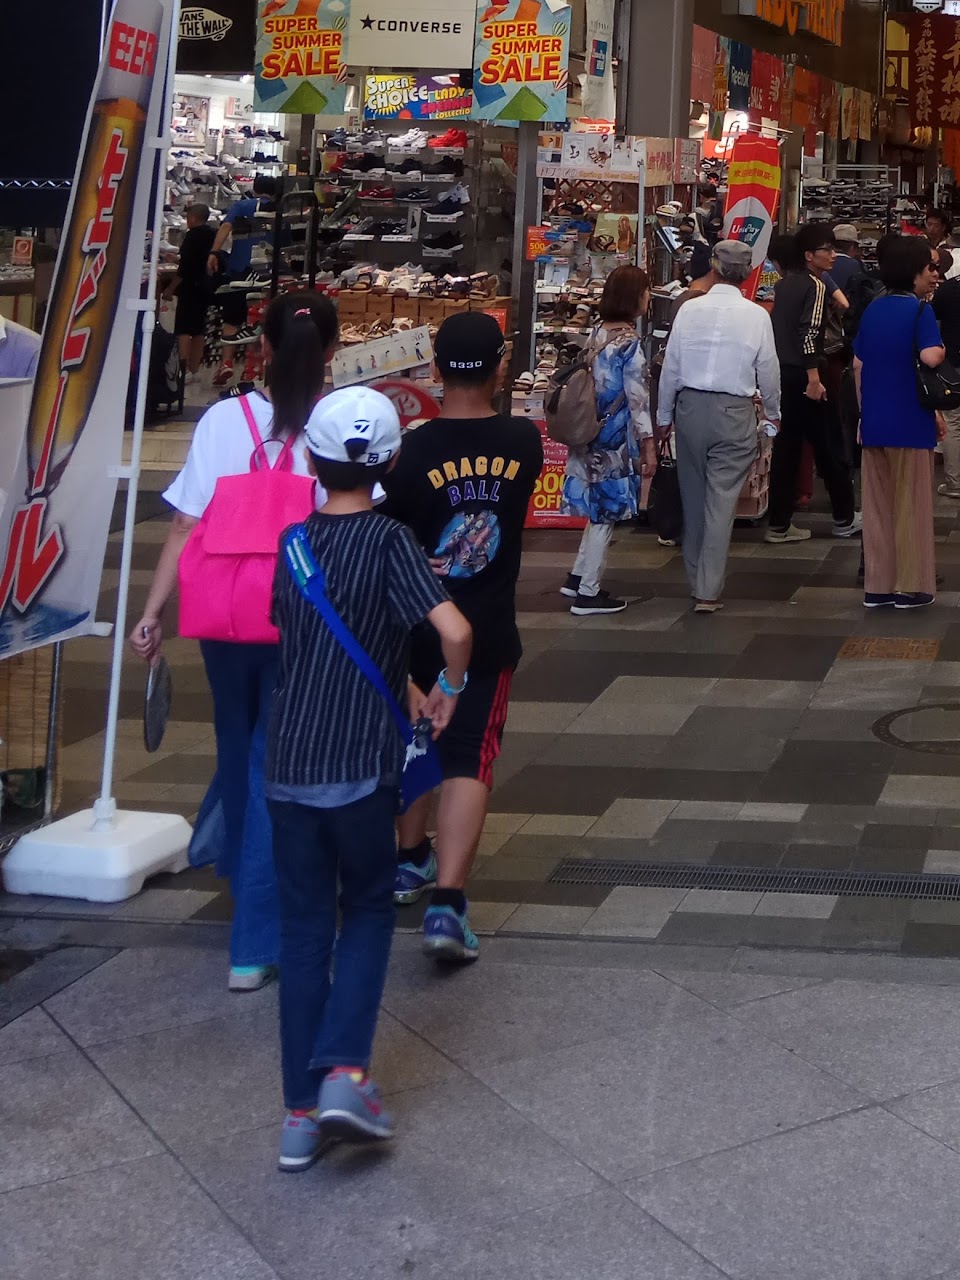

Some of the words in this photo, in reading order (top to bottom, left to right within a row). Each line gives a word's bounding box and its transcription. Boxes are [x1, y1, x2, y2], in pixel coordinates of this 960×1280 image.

[180, 21, 200, 36] THE
[201, 19, 227, 35] WALL
[263, 17, 318, 34] SUPER
[377, 19, 462, 34] CONVERSE
[483, 22, 538, 39] SUPER
[272, 32, 342, 50] SUMMER
[491, 39, 562, 56] SUMMER
[260, 50, 341, 79] SALE
[479, 55, 561, 85] SALE
[366, 74, 411, 95] SUPER
[366, 84, 429, 111] CHOICE
[434, 108, 472, 119] COLLECTIO
[426, 455, 521, 490] DRAGON
[446, 479, 501, 507] BALL
